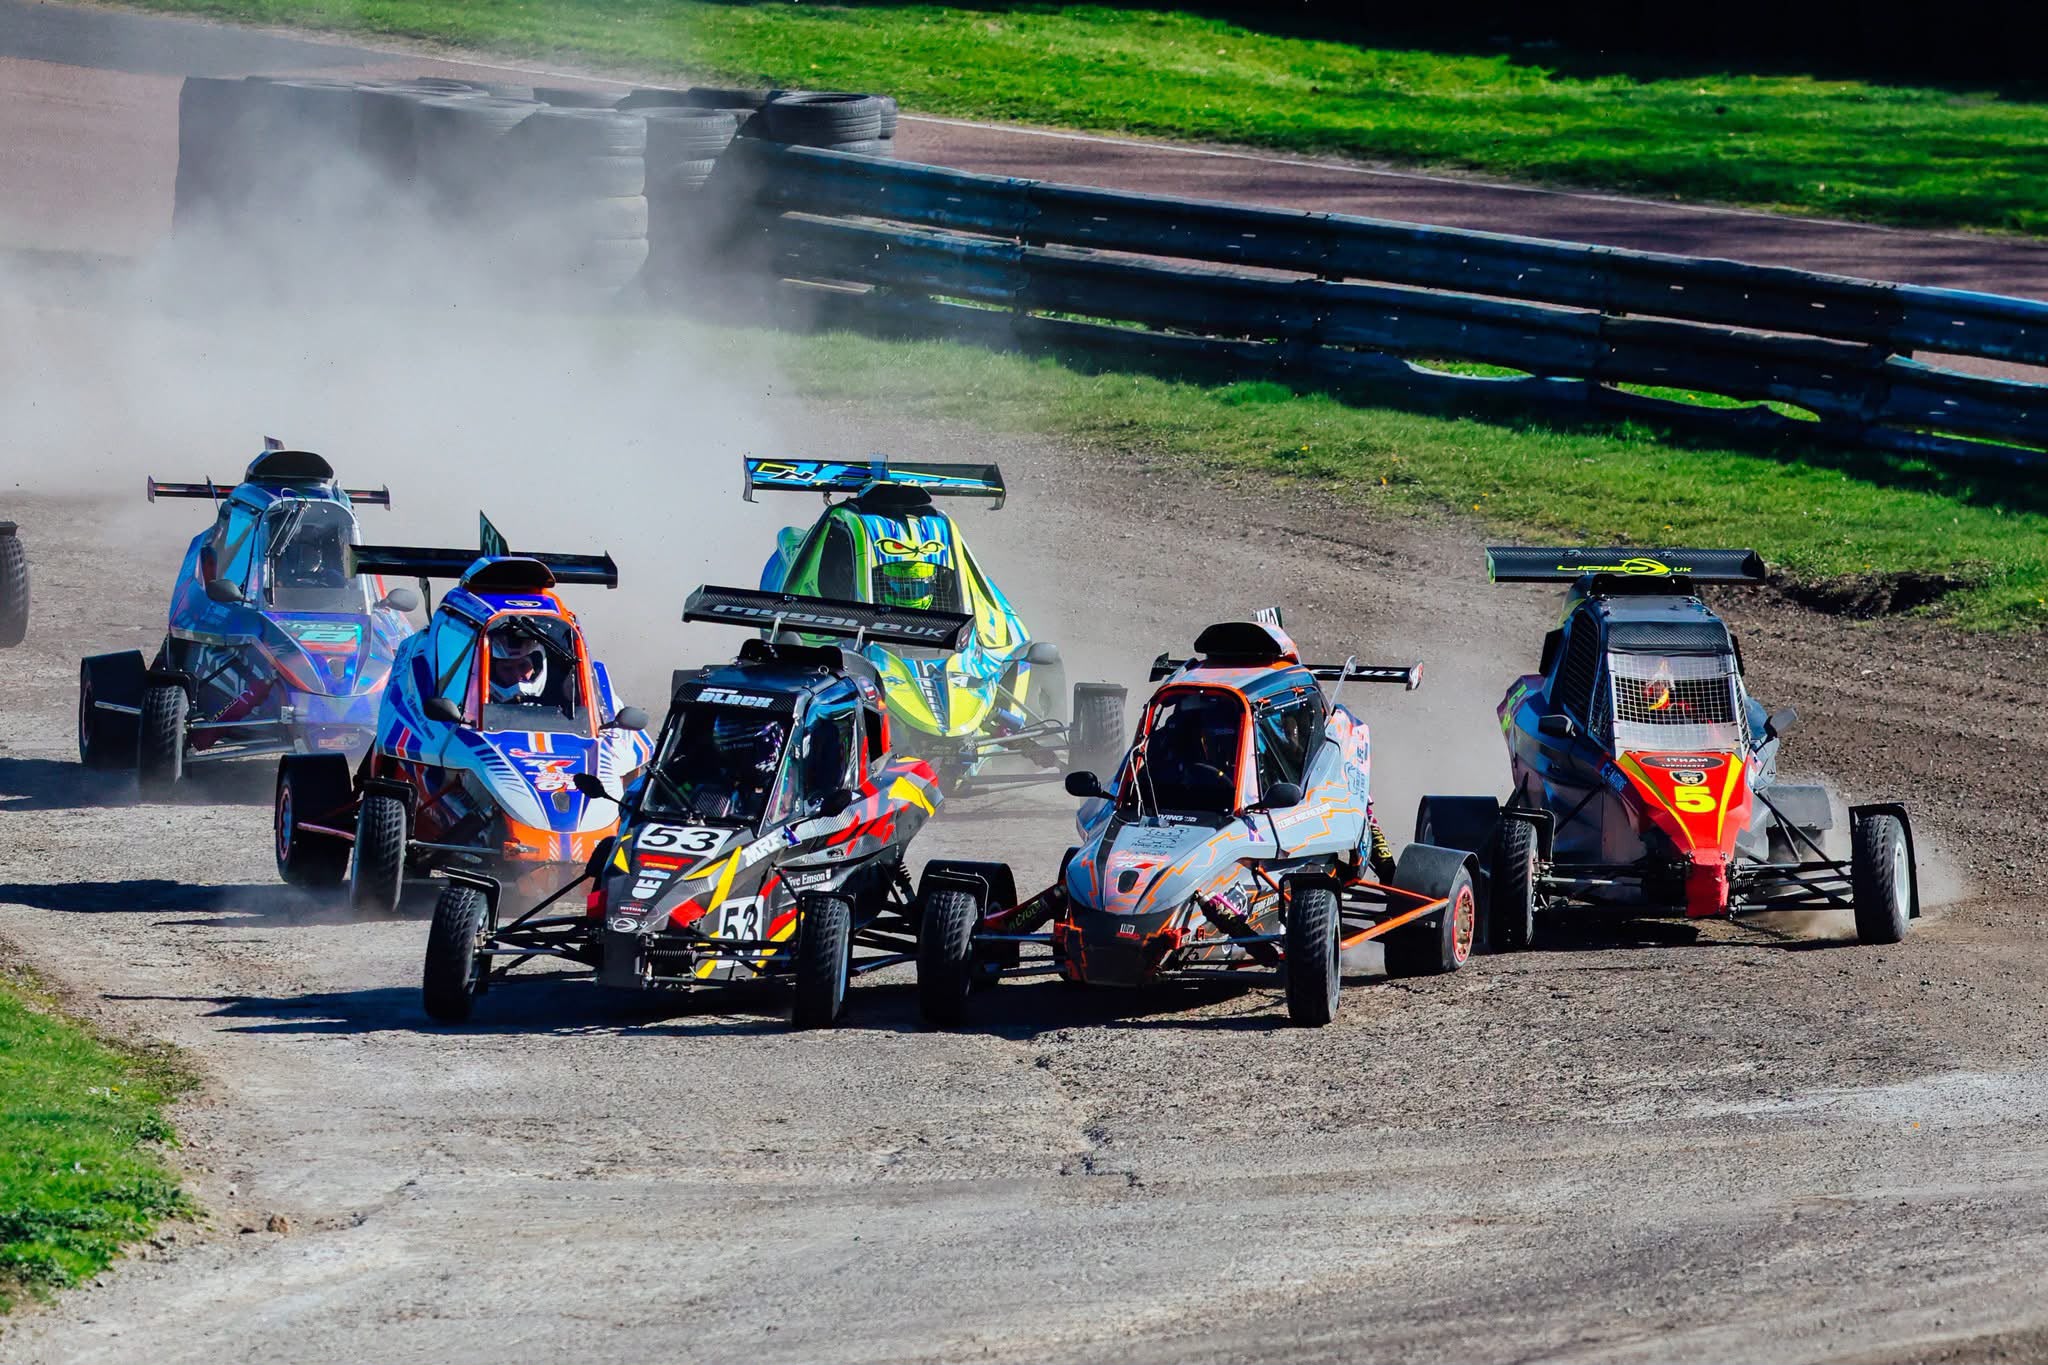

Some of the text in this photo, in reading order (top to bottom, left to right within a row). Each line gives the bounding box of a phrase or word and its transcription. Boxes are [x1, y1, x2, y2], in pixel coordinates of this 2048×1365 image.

[903, 625, 947, 638] UK
[696, 691, 774, 708] BLACK
[1674, 785, 1717, 814] 5
[641, 827, 720, 852] 53
[801, 871, 826, 885] Emson
[722, 903, 758, 948] 53
